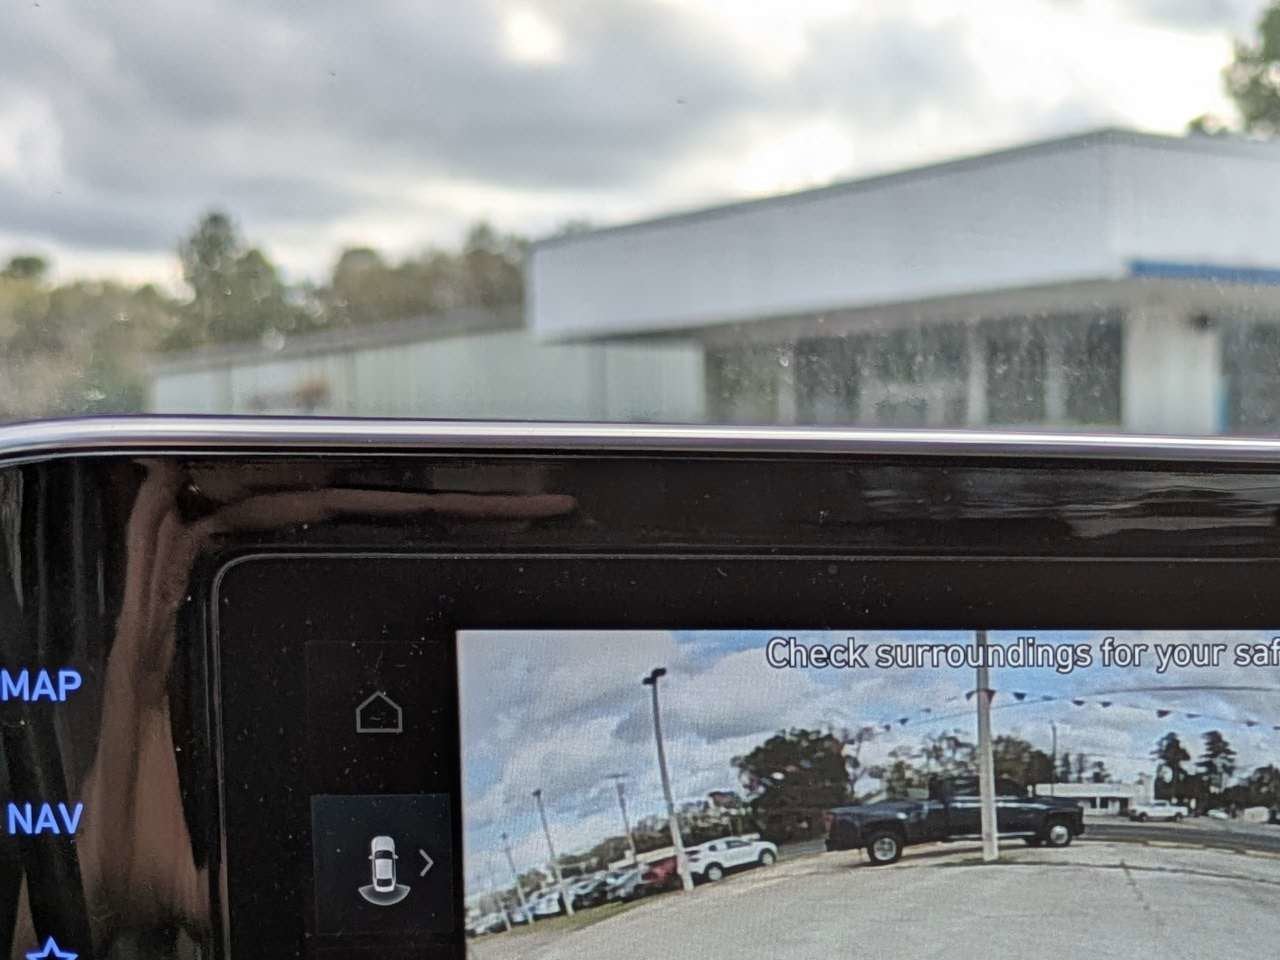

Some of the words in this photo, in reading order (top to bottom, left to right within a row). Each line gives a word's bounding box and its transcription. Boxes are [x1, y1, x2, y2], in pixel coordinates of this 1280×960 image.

[766, 637, 868, 669] Check
[874, 637, 1092, 673] surroundings
[1101, 637, 1146, 668] for
[1155, 643, 1226, 673] your
[0, 669, 82, 701] MAP
[7, 802, 83, 834] NAV
